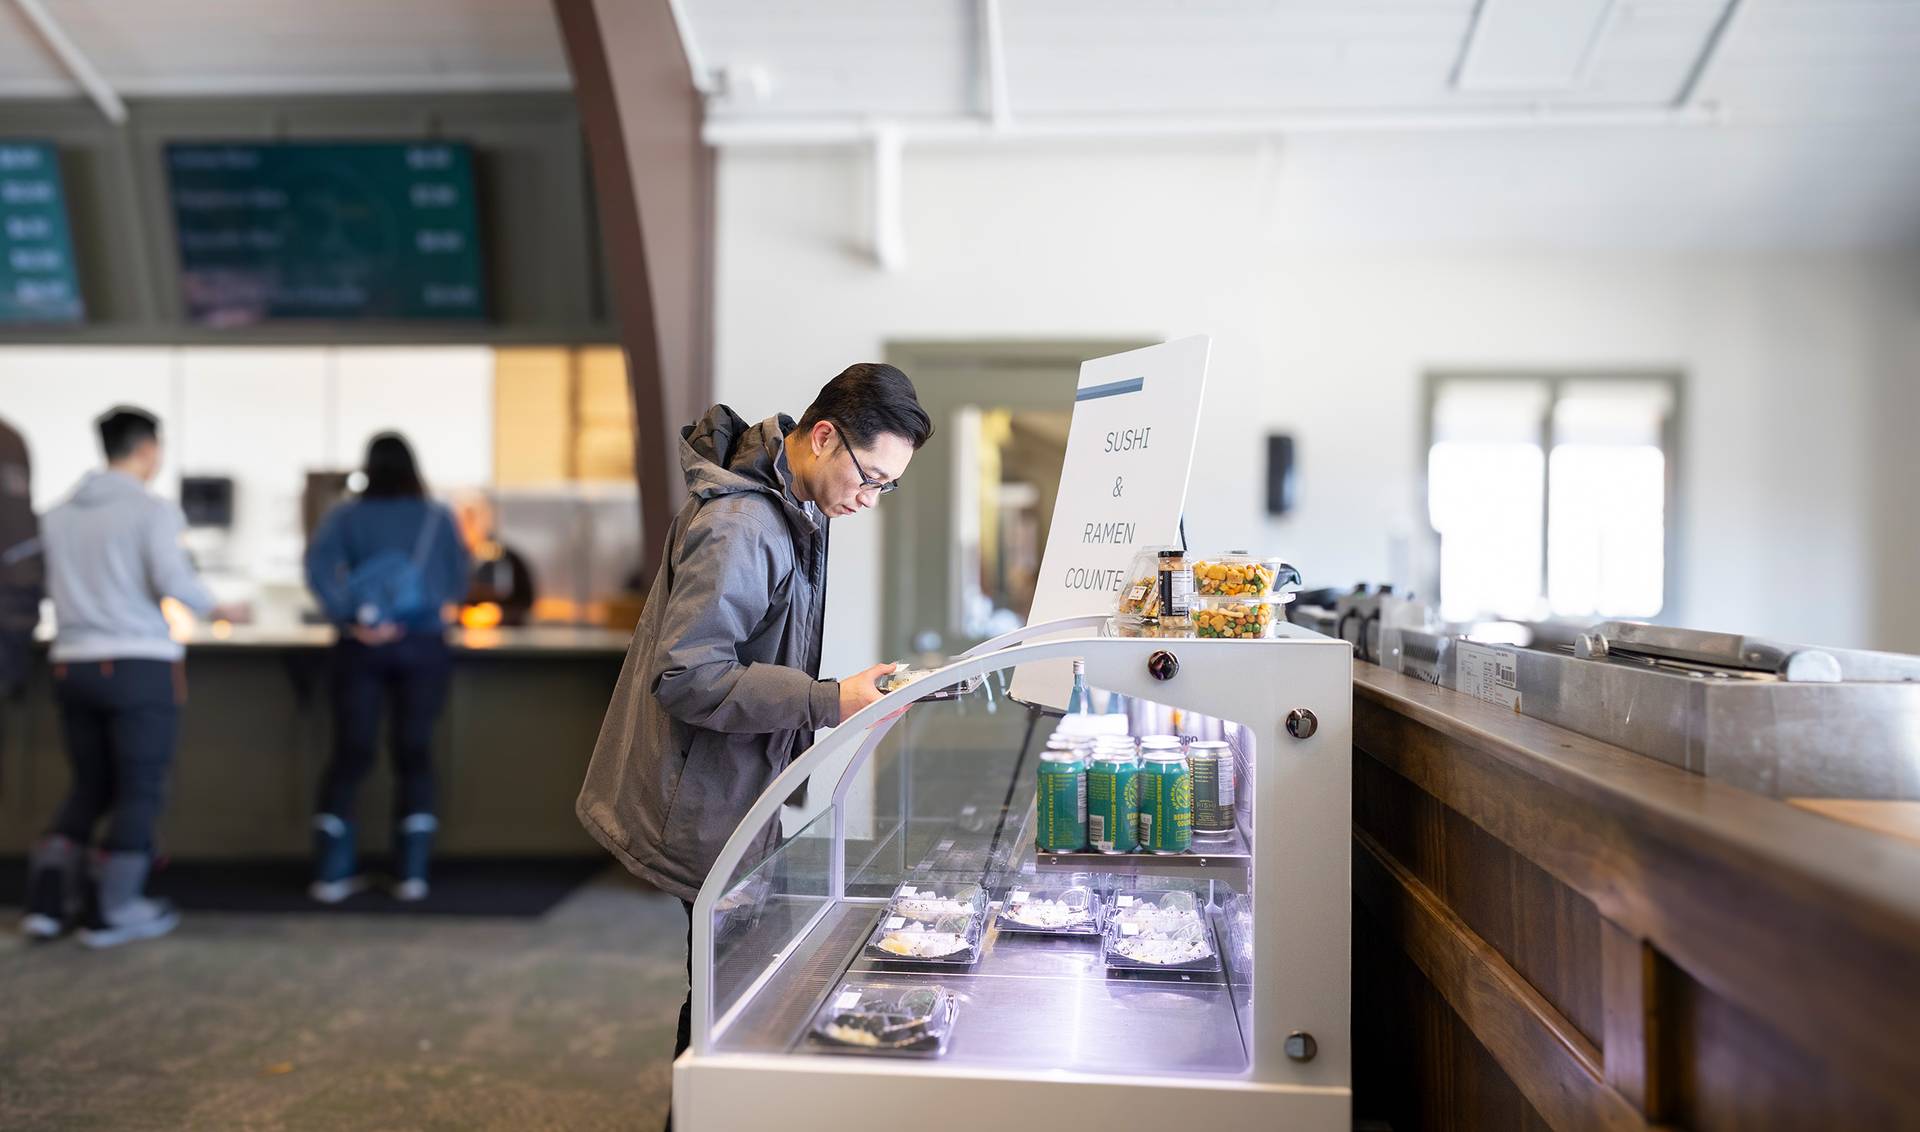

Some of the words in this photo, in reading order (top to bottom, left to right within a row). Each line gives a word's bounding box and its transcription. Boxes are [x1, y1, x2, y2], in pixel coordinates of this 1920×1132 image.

[1104, 426, 1152, 453] SUSHI
[1112, 476, 1123, 498] &
[1082, 522, 1136, 545] RAMEN
[1064, 566, 1124, 592] COUNTE
